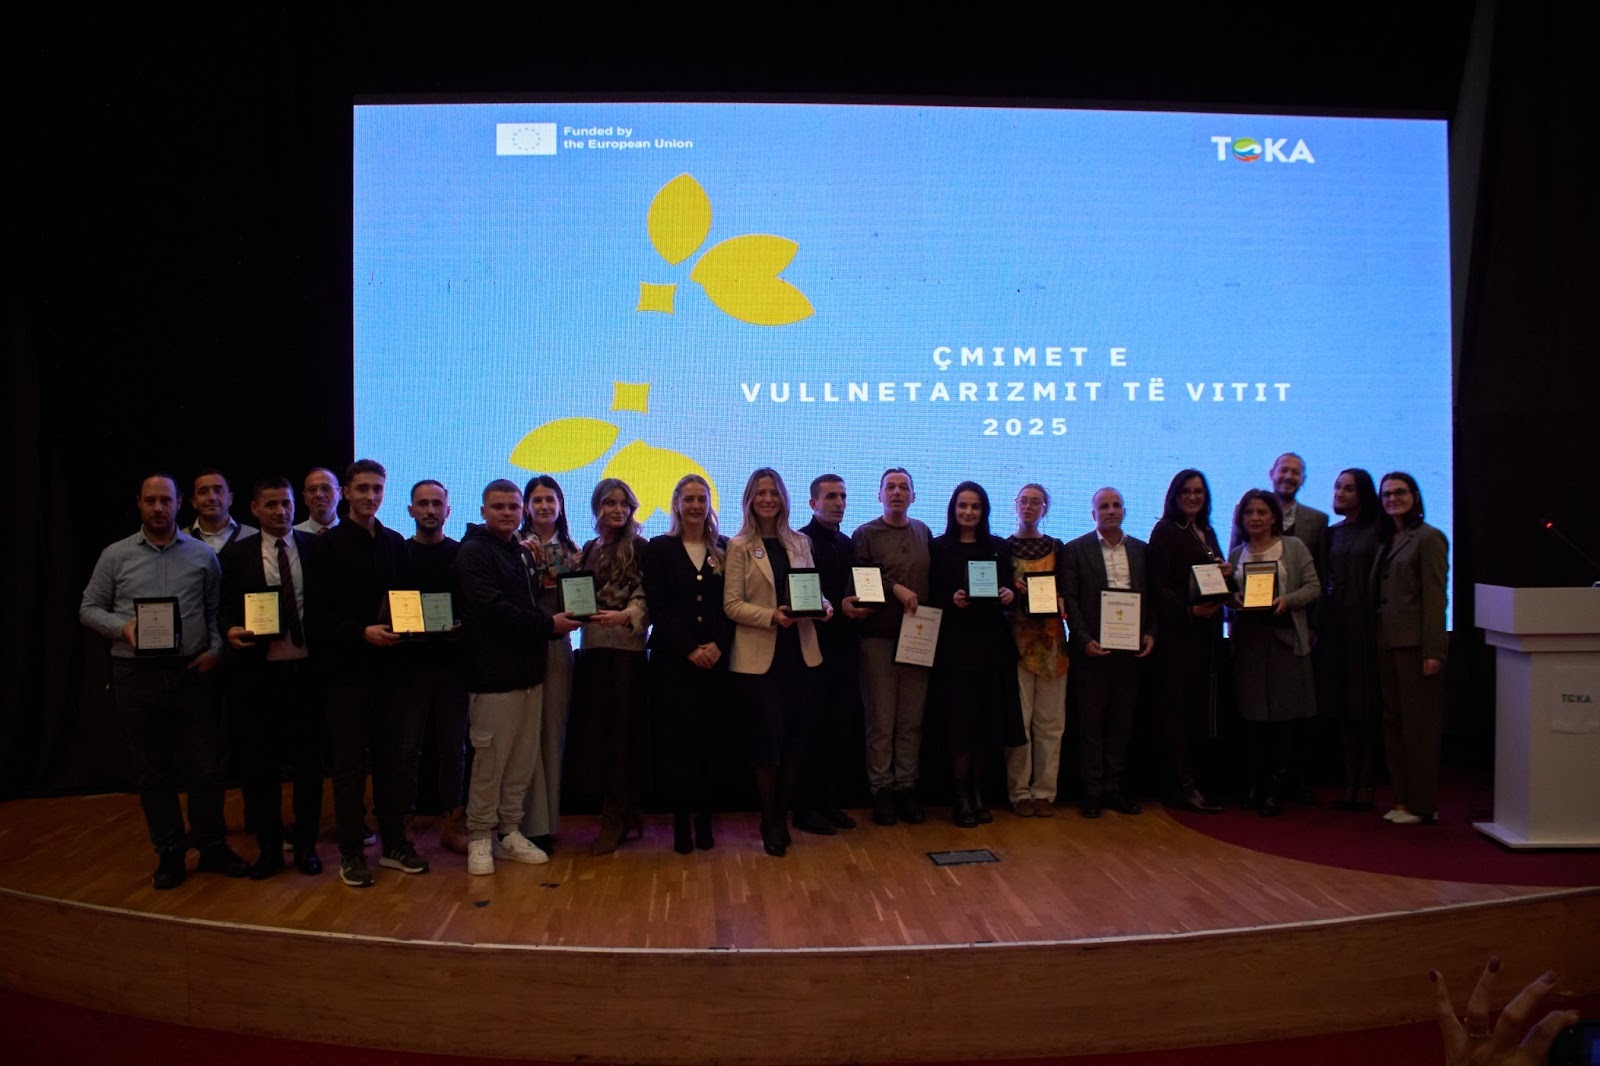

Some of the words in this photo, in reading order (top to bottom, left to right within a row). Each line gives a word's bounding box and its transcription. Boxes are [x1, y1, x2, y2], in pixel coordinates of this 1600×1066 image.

[563, 126, 613, 136] Funded
[616, 126, 633, 138] by
[563, 139, 584, 149] the
[588, 139, 651, 151] European
[654, 138, 693, 149] Union
[1211, 136, 1315, 163] TOKA
[933, 346, 1088, 372] ÇMIMET
[1110, 347, 1127, 367] E
[740, 381, 1102, 403] VULLNETARIZMIT
[1123, 376, 1164, 402] TË
[1187, 382, 1292, 402] VITIT
[982, 417, 1068, 436] 2025
